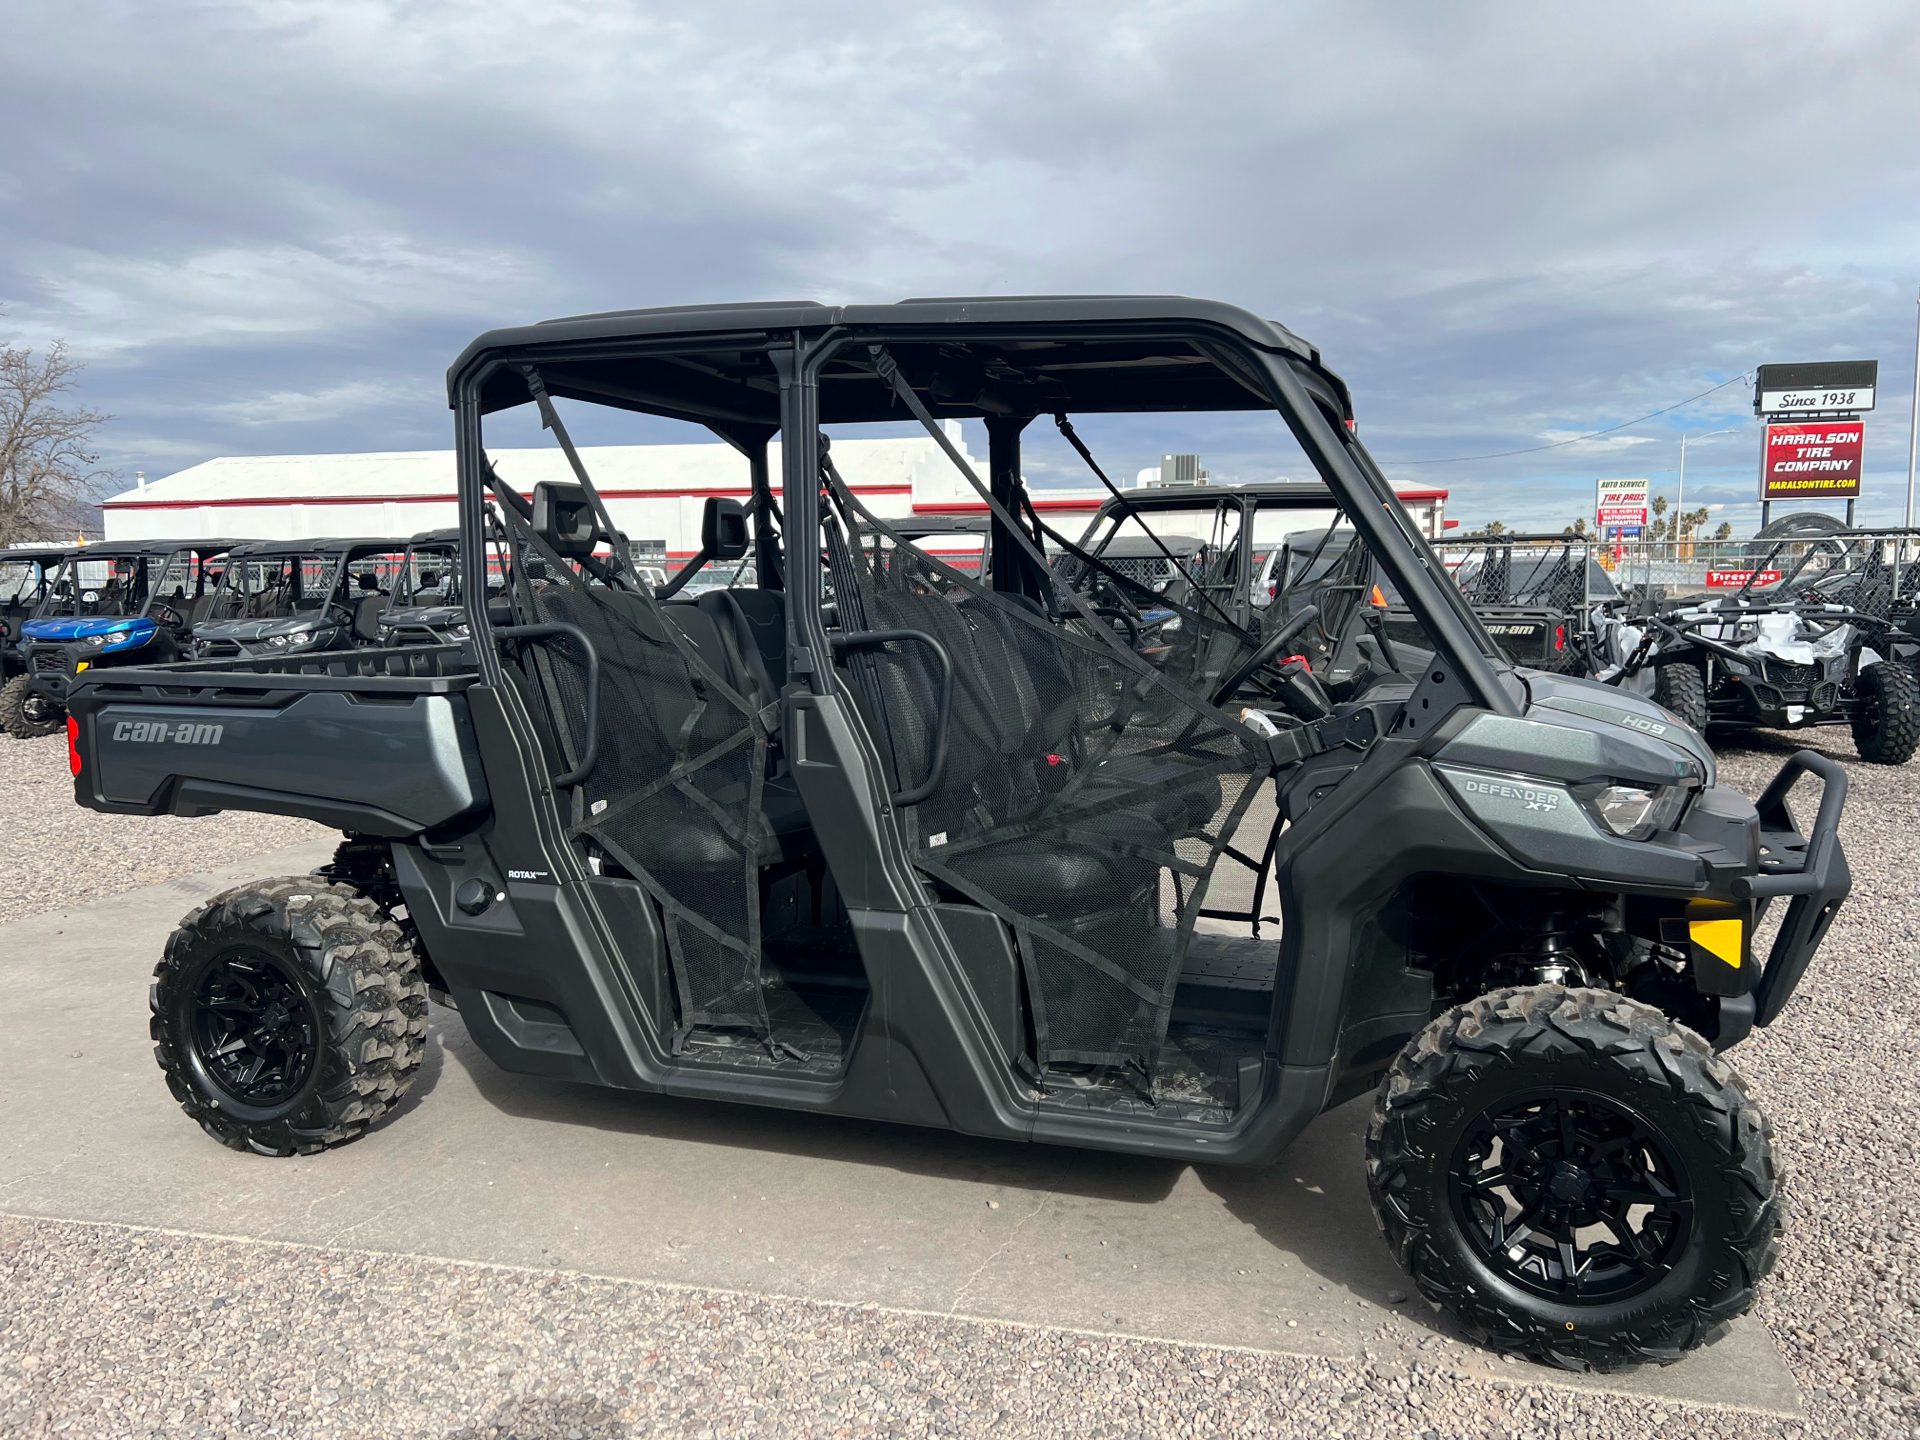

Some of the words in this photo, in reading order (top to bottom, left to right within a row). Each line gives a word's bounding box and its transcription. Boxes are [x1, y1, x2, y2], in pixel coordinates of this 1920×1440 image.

[1779, 394, 1816, 408] Since
[1821, 392, 1856, 405] 1938
[1771, 432, 1859, 446] HARALSON
[1796, 447, 1833, 458] TIRE
[1773, 460, 1853, 472] COMPANY
[1619, 480, 1646, 488] SERVICE
[1768, 479, 1856, 489] HARALSONTIRE.COM
[1601, 494, 1622, 506] TIRE
[1620, 493, 1646, 505] PROS
[1711, 572, 1775, 582] Firestne
[1484, 625, 1535, 634] an-am
[1621, 714, 1667, 735] HD9
[112, 721, 224, 745] can-am
[1466, 780, 1559, 805] DEFENDER
[1524, 801, 1557, 812] XT
[508, 870, 537, 879] ROTAX
